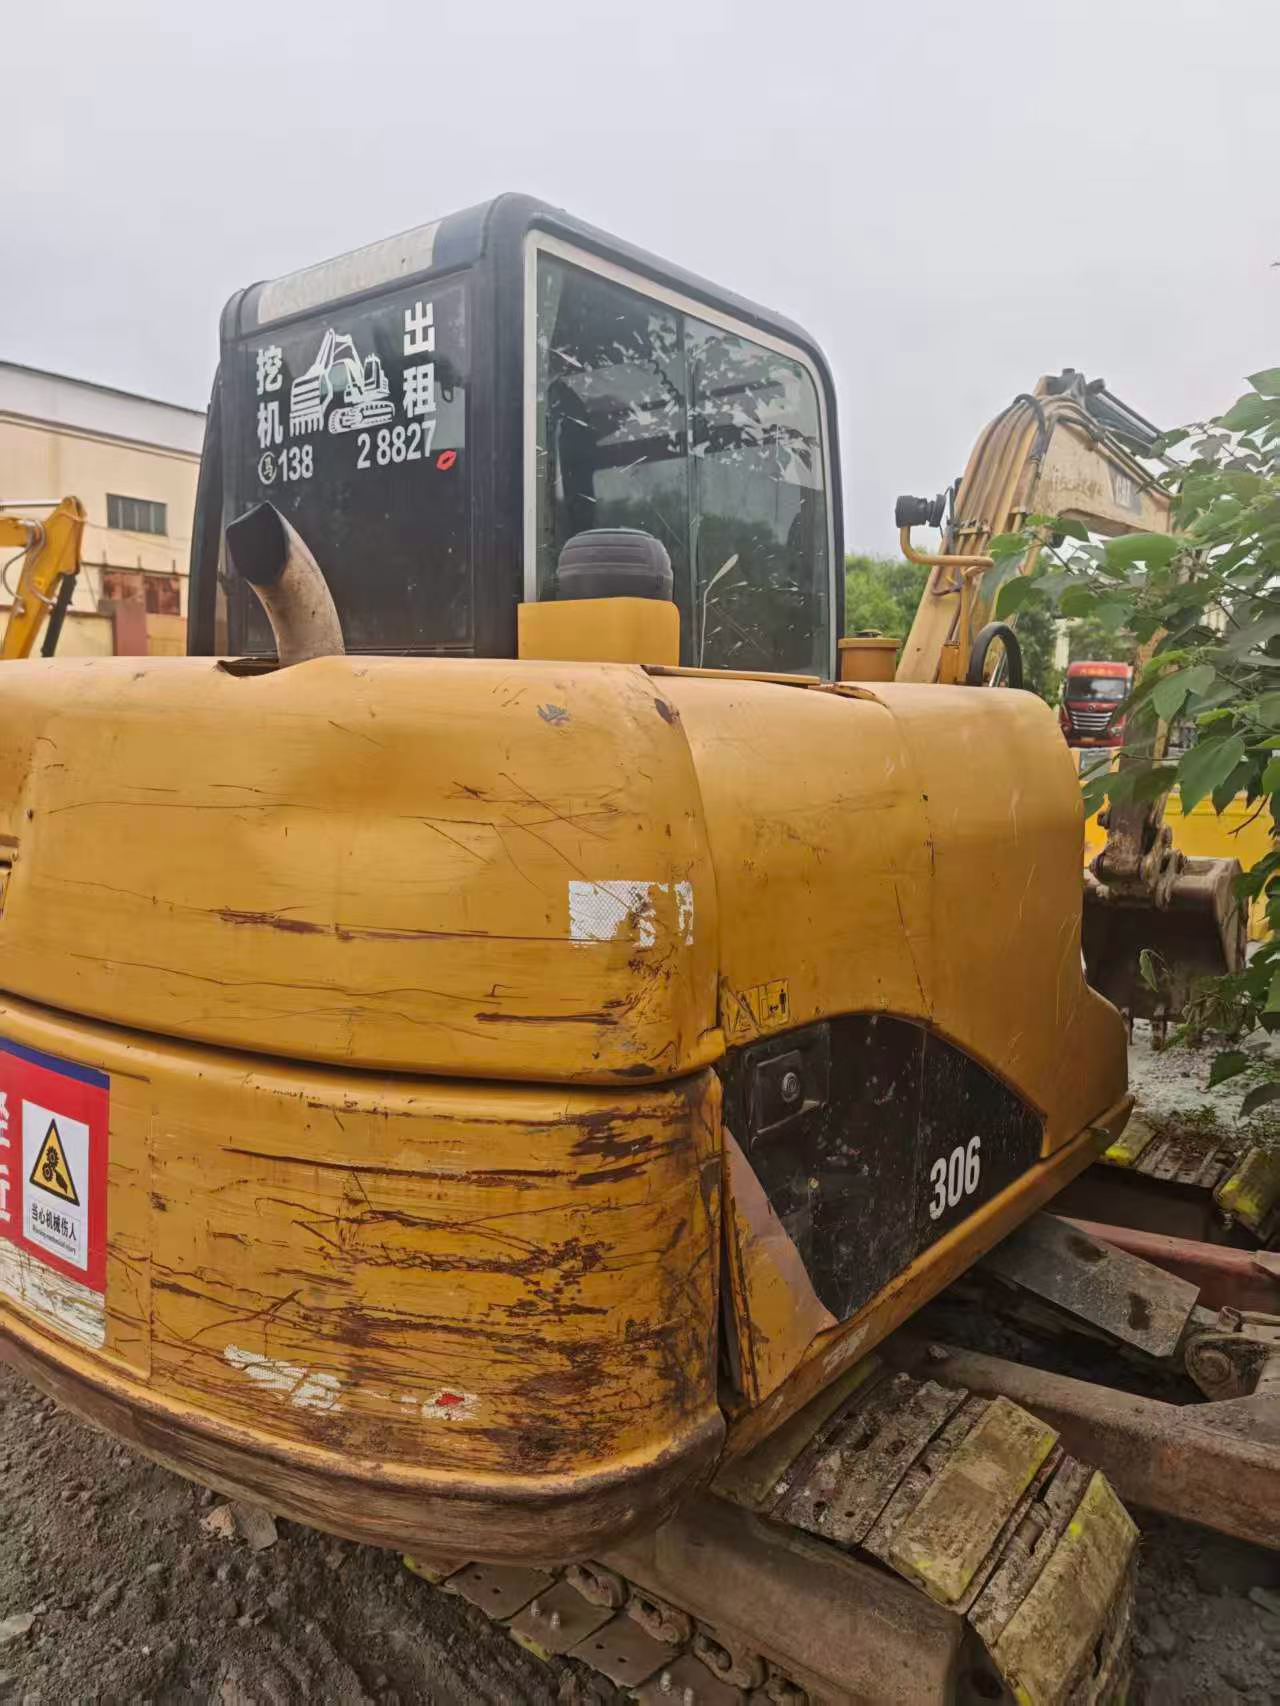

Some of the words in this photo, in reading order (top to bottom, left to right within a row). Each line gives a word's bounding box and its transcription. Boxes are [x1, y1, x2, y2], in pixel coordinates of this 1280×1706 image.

[256, 345, 283, 449] 挖机
[403, 301, 436, 418] 出租
[278, 444, 313, 482] 138
[929, 1135, 981, 1220] 306
[31, 1202, 77, 1241] 当心机械伤人
